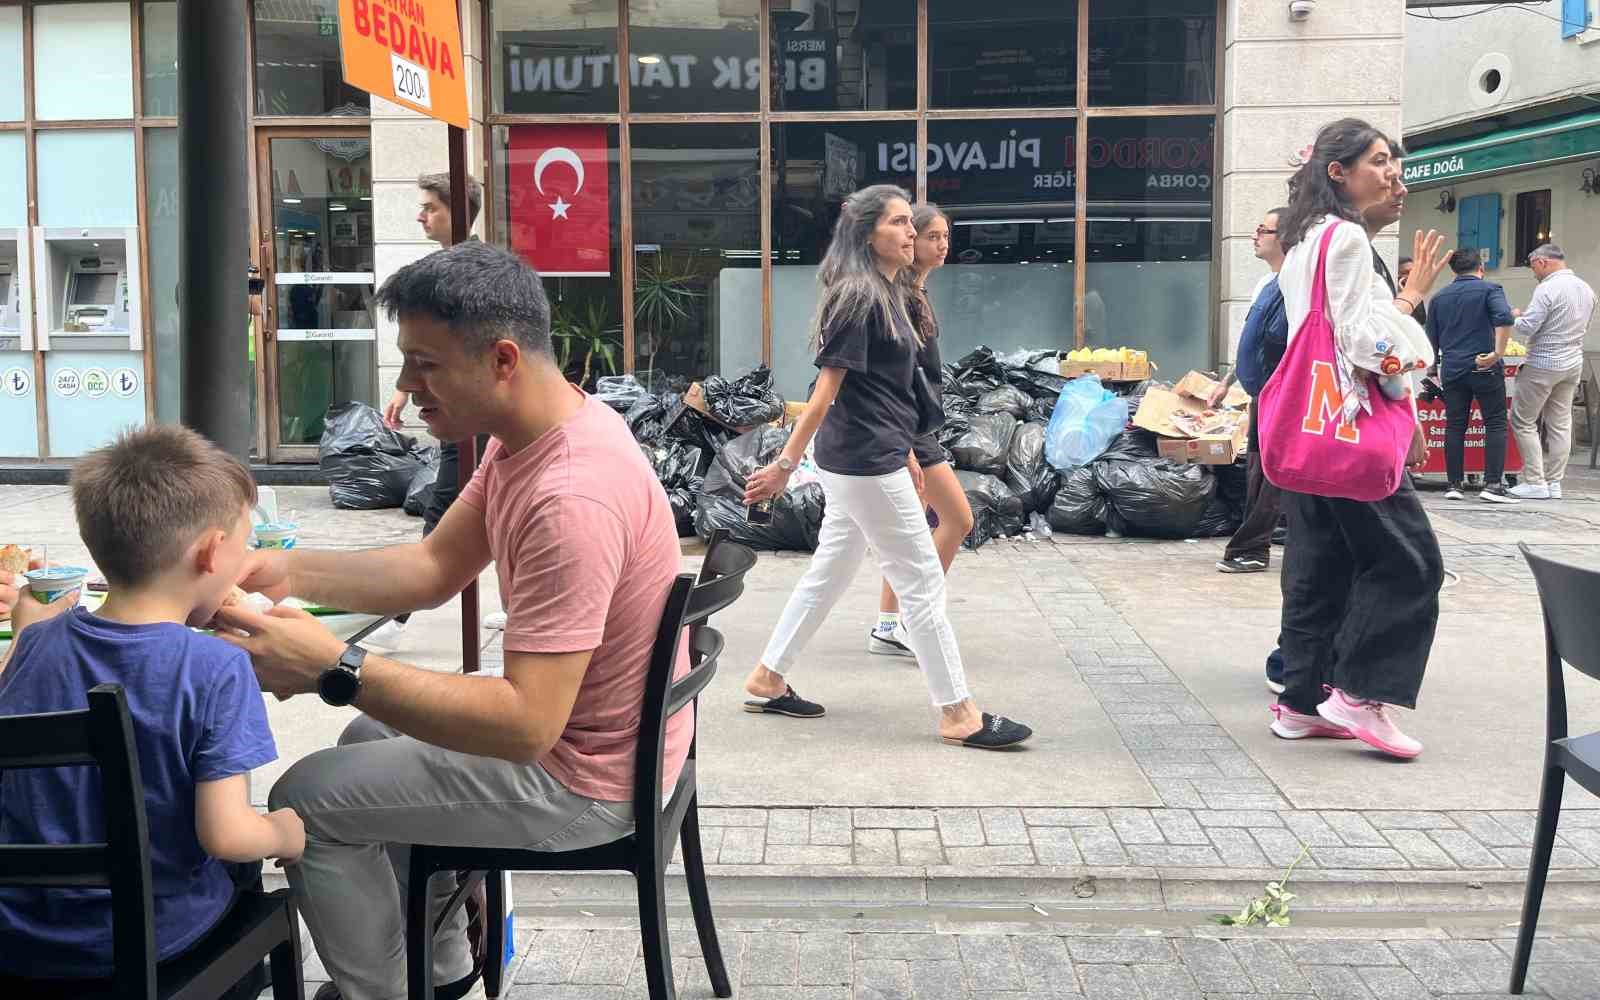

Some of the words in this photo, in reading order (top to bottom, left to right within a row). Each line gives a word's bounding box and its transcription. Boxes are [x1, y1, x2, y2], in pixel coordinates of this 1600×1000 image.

[352, 0, 455, 80] BEDAVA
[383, 0, 425, 27] YRAN
[1404, 164, 1431, 180] CAFE
[1433, 156, 1464, 175] DOĞA
[1301, 359, 1360, 444] M
